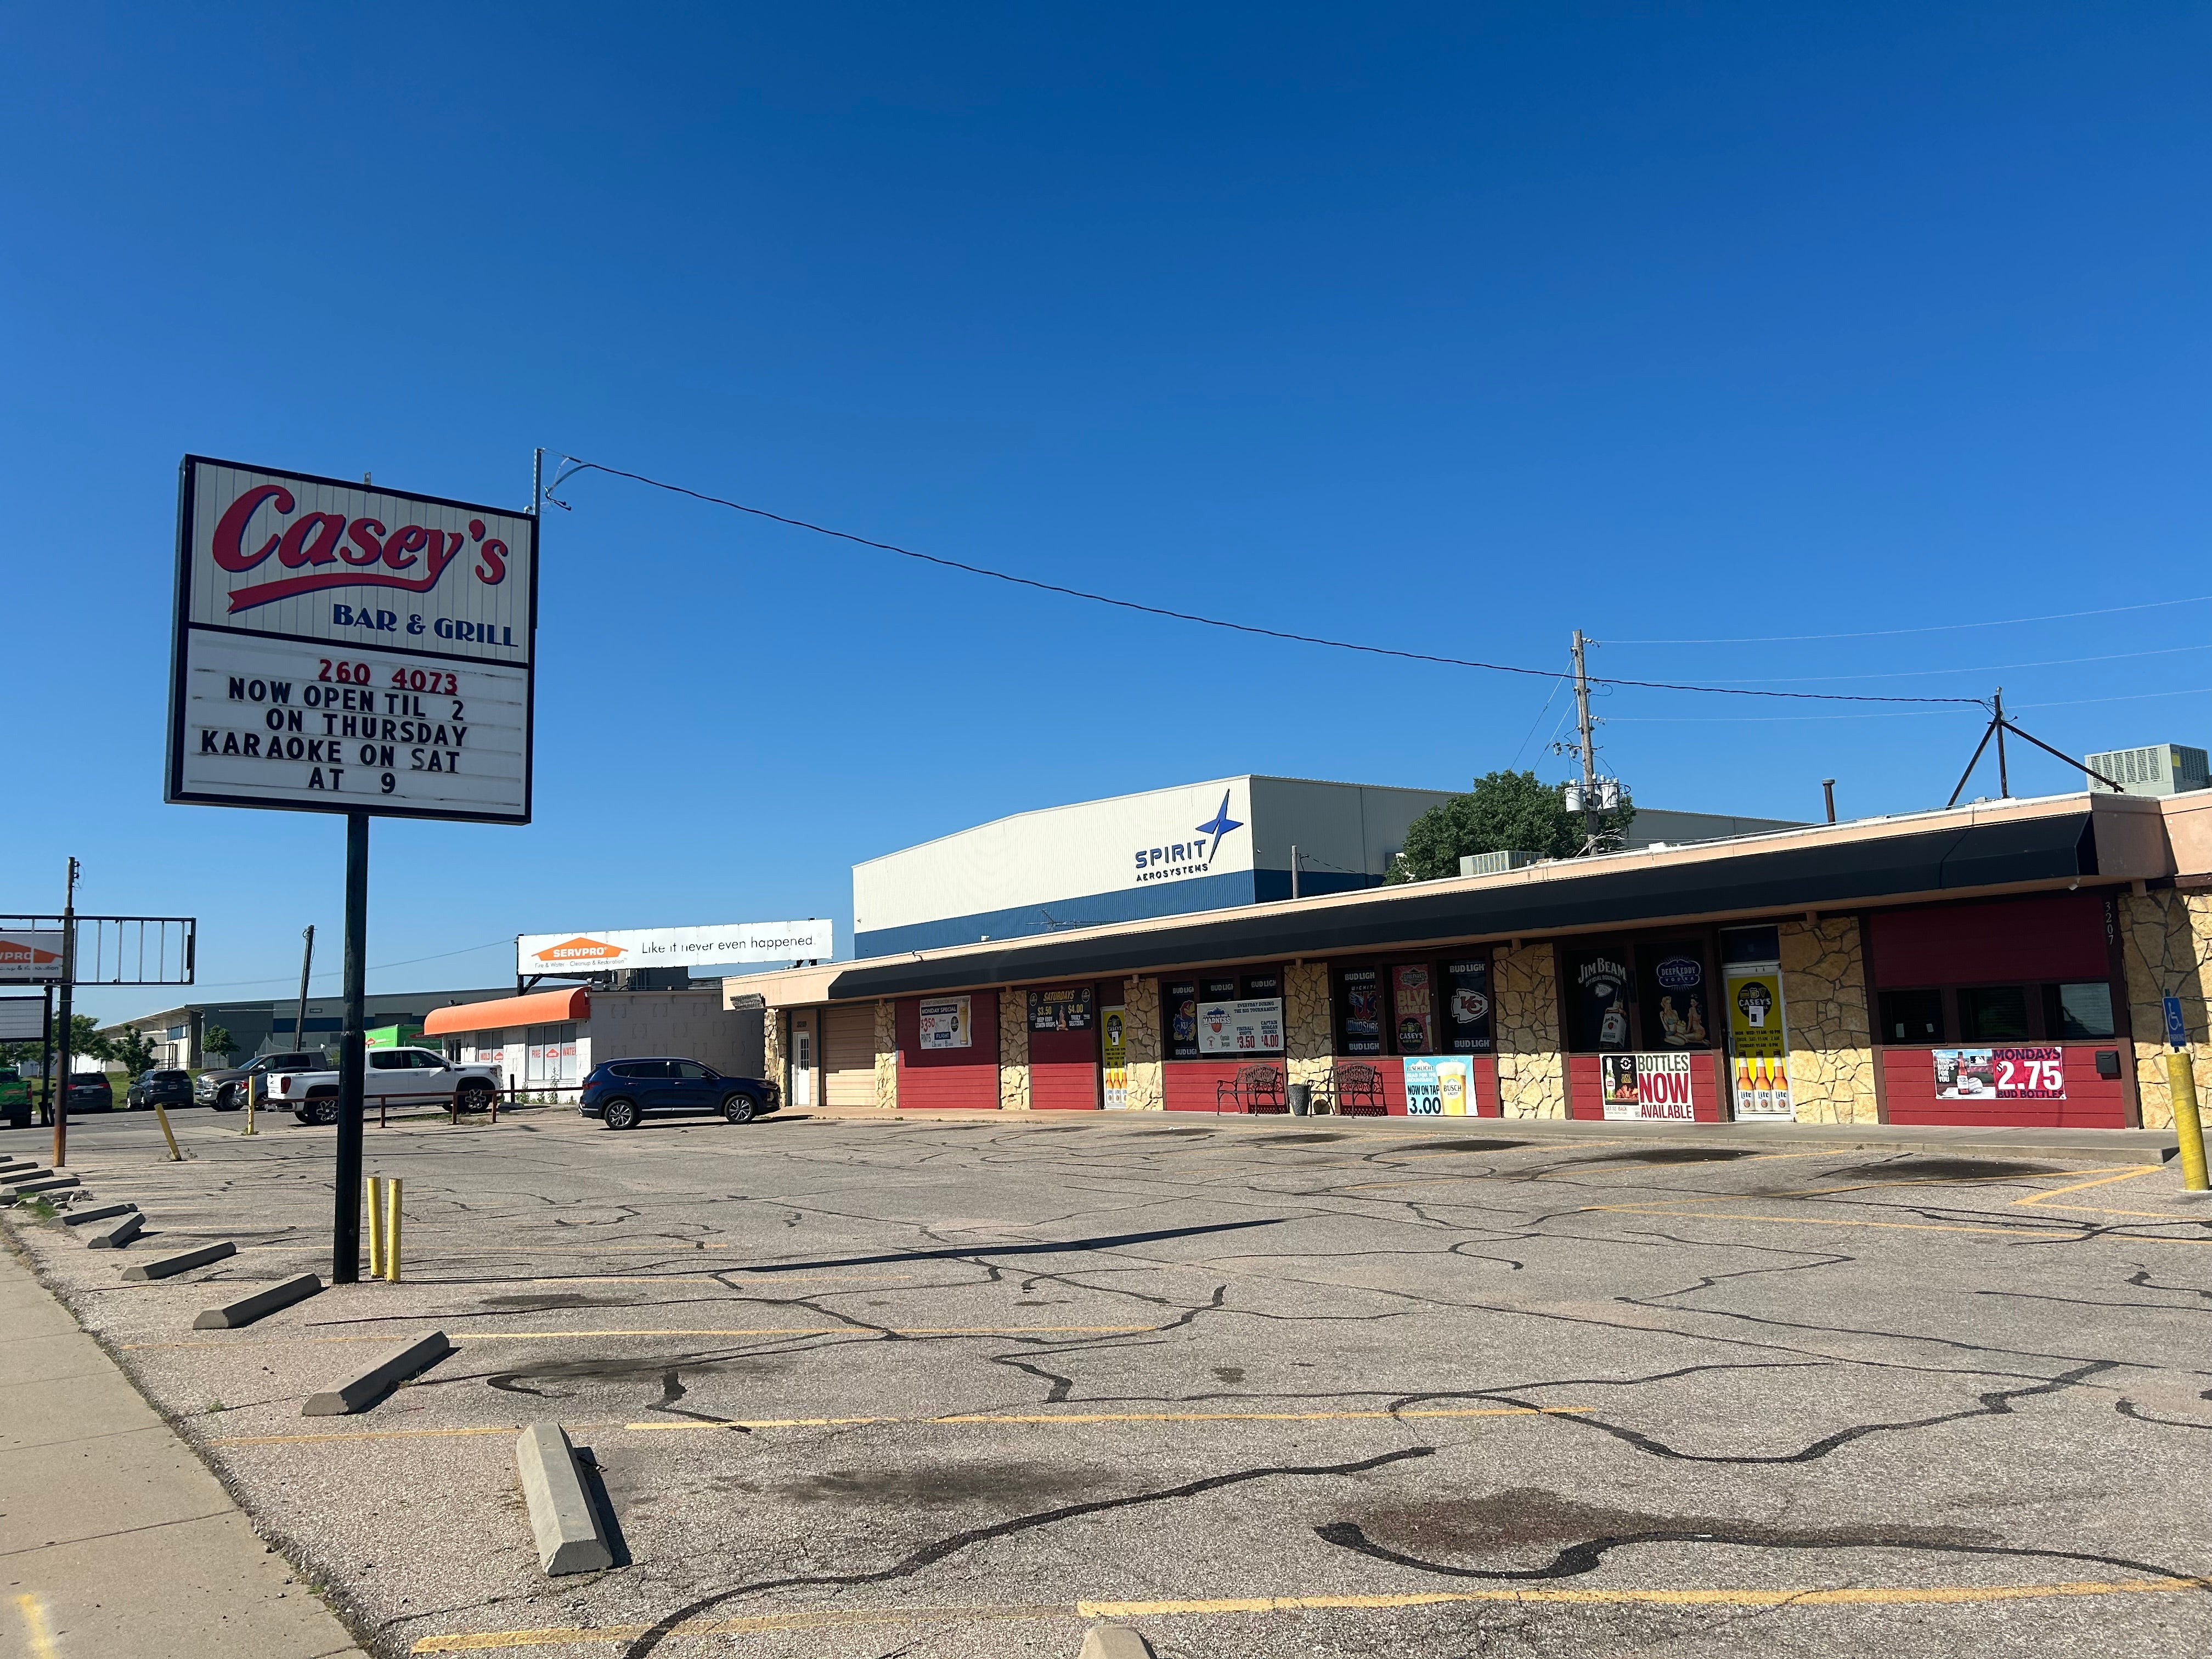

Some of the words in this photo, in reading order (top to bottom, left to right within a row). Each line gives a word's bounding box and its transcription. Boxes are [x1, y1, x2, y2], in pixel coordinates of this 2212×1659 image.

[212, 484, 508, 597] Casey's
[334, 603, 397, 632] BAR
[407, 614, 426, 635] &
[434, 617, 518, 647] GRILL
[319, 659, 371, 685] 260
[391, 669, 458, 695] 4073
[229, 676, 292, 704] NOW
[304, 685, 373, 713] OPEN
[385, 693, 426, 718] TIL
[452, 701, 464, 721] 2
[266, 708, 302, 732] ON
[323, 713, 468, 747] THURSDAY
[201, 730, 341, 763] KARAOKE
[360, 744, 394, 767] ON
[410, 748, 460, 773] SAT
[308, 768, 344, 790] AT
[381, 772, 396, 793] 9
[1135, 839, 1206, 868] SPIRIT
[1136, 863, 1208, 882] AEROSYSTEMS
[553, 947, 605, 958] SERVPRO
[642, 941, 665, 953] Like
[670, 942, 676, 952] it
[681, 943, 714, 952] never
[718, 941, 746, 950] even
[1450, 965, 1465, 973] BUD
[1578, 962, 1596, 984] JIM
[1597, 958, 1627, 983] BEAM
[1661, 968, 1675, 976] DEEP
[1043, 990, 1075, 1002] SATURDAYS
[1037, 1006, 1052, 1016] $3.50
[1068, 1004, 1084, 1014] $4.00
[1398, 1005, 1420, 1014] GAME
[1237, 1035, 1255, 1048] $3.50
[1261, 1035, 1279, 1048] $4.00
[1637, 1054, 1689, 1071] BOTTLES
[1993, 1048, 2061, 1060] MONDAYS
[1407, 1085, 1420, 1095] NOW
[1421, 1085, 1429, 1095] ON
[1430, 1085, 1440, 1095] TAP
[1639, 1073, 1688, 1103] NOW
[1996, 1090, 2018, 1098] BUD
[2019, 1089, 2064, 1098] BOTTLES
[1409, 1097, 1441, 1114] 3.00
[1641, 1104, 1692, 1119] AVAILABLE
